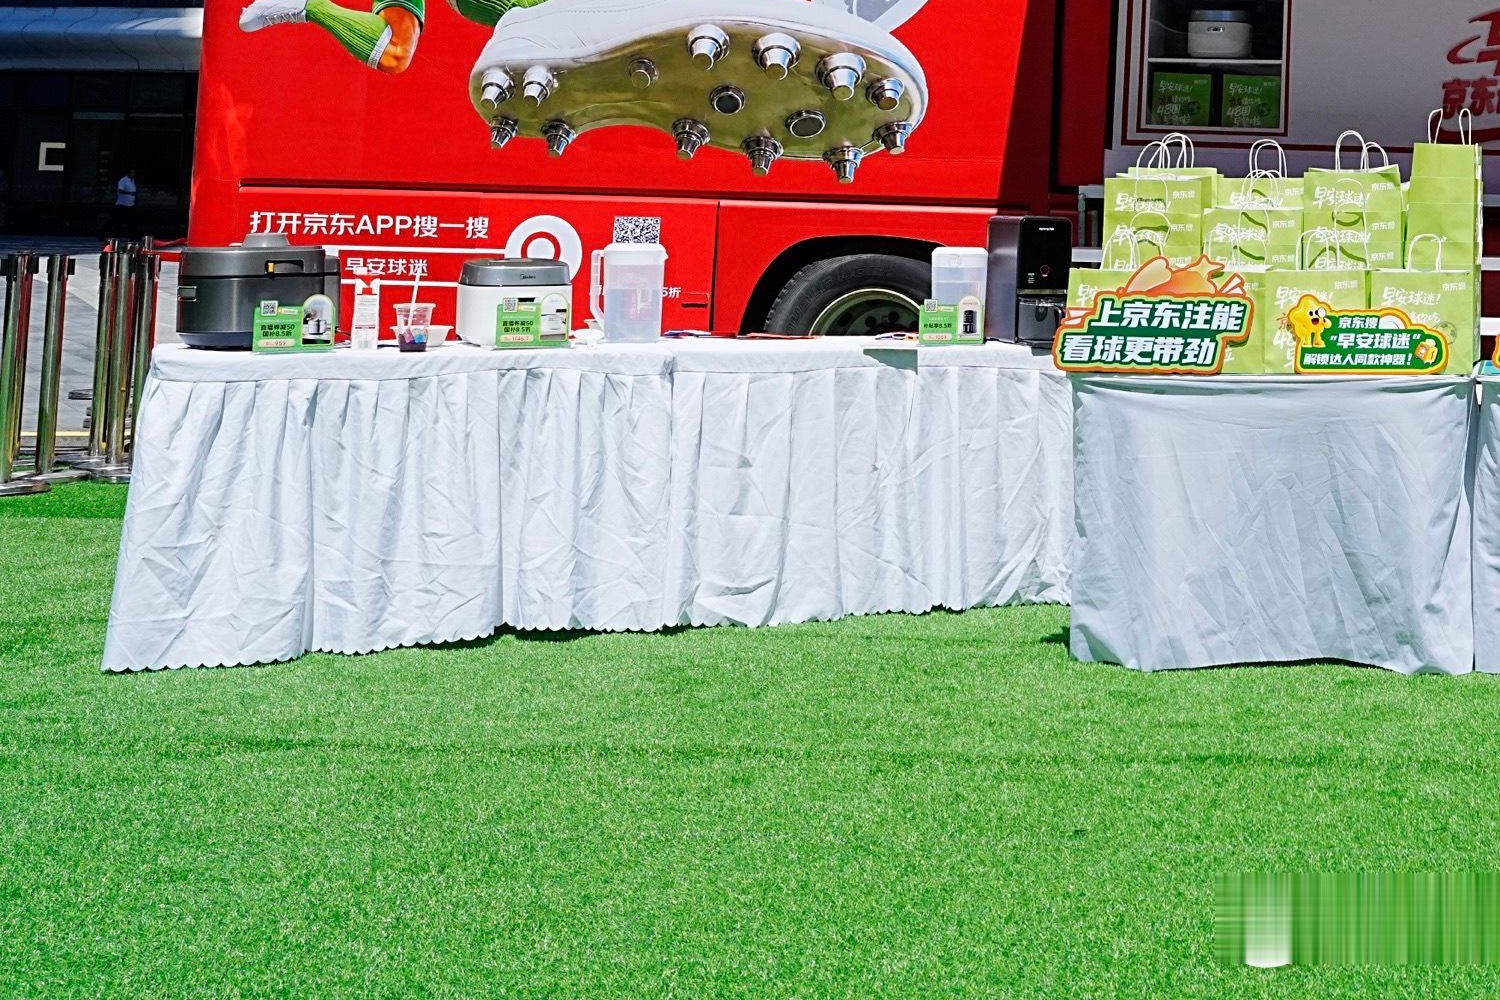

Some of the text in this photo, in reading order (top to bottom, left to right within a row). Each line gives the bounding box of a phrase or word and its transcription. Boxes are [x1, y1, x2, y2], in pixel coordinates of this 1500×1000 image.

[249, 211, 490, 240] 打开京东APP搜一搜
[345, 257, 428, 277] 早安球迷
[1382, 286, 1441, 307] 早安球迷!
[1091, 301, 1245, 331] 上京东注能
[1338, 316, 1381, 329] 京东搜
[1063, 335, 1216, 365] 看球更带劲
[1303, 353, 1413, 366] 解锁达人同款神器!
